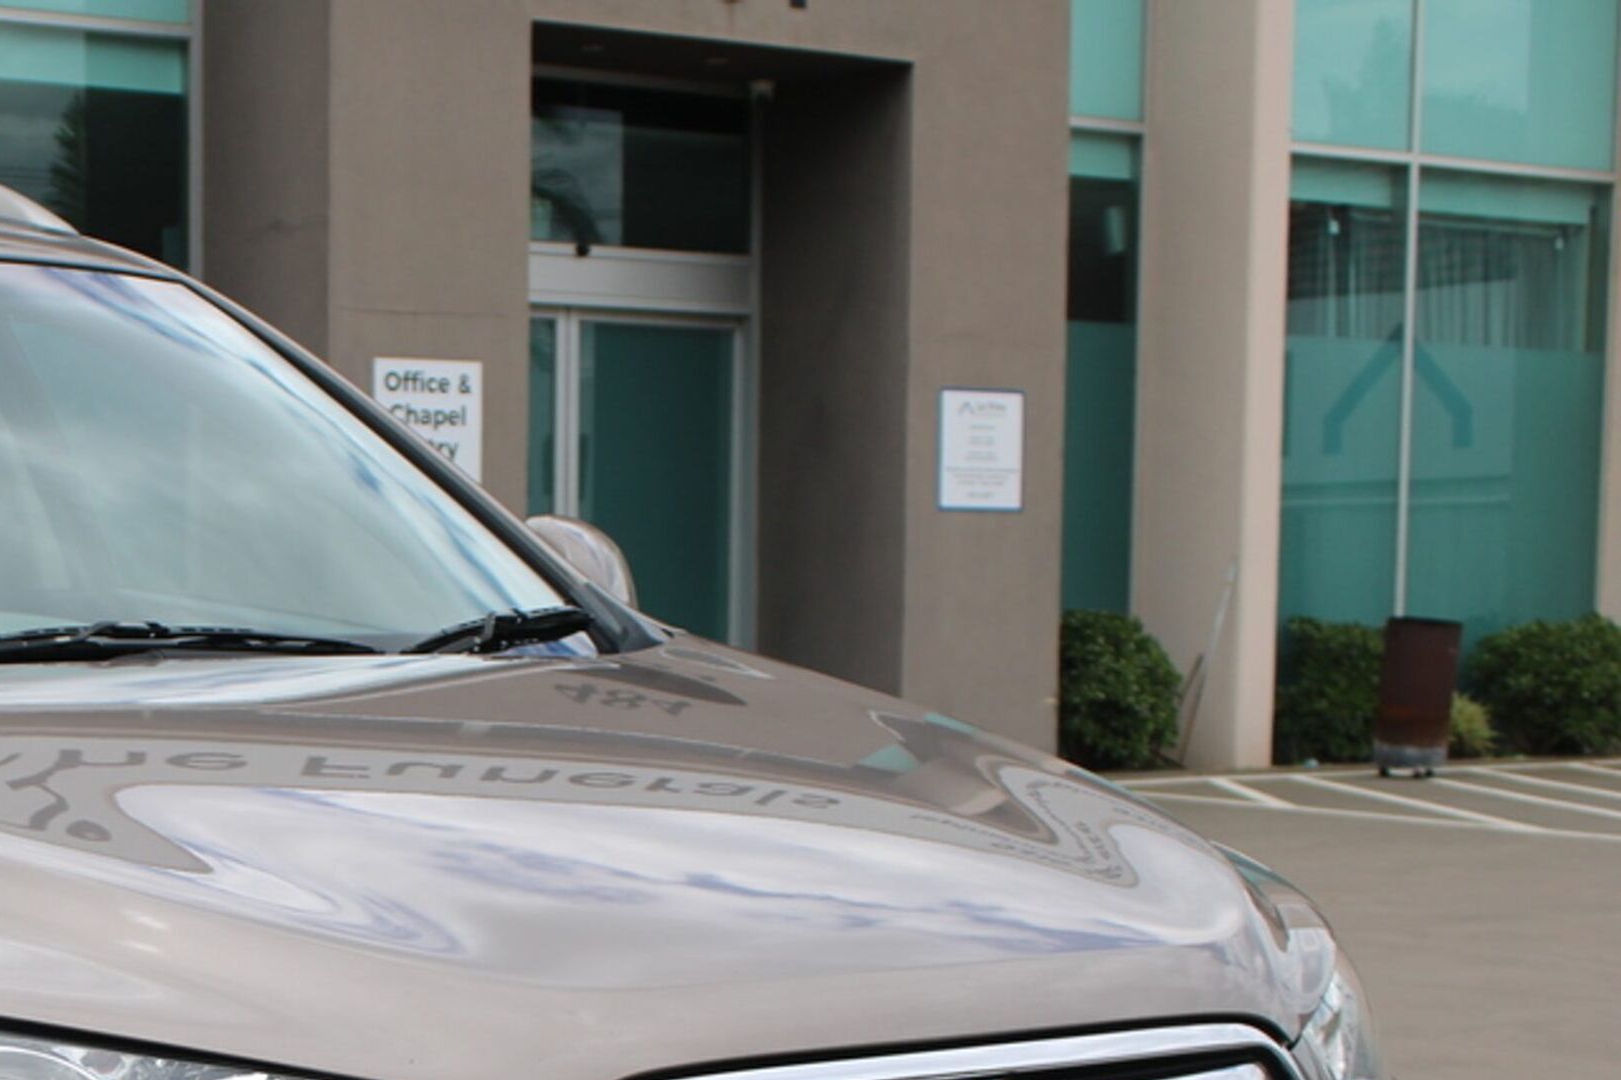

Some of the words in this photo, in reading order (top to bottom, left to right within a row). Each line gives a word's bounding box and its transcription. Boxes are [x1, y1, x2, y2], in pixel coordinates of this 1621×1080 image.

[384, 370, 450, 393] Office
[458, 374, 471, 393] &
[390, 403, 467, 430] Chapel
